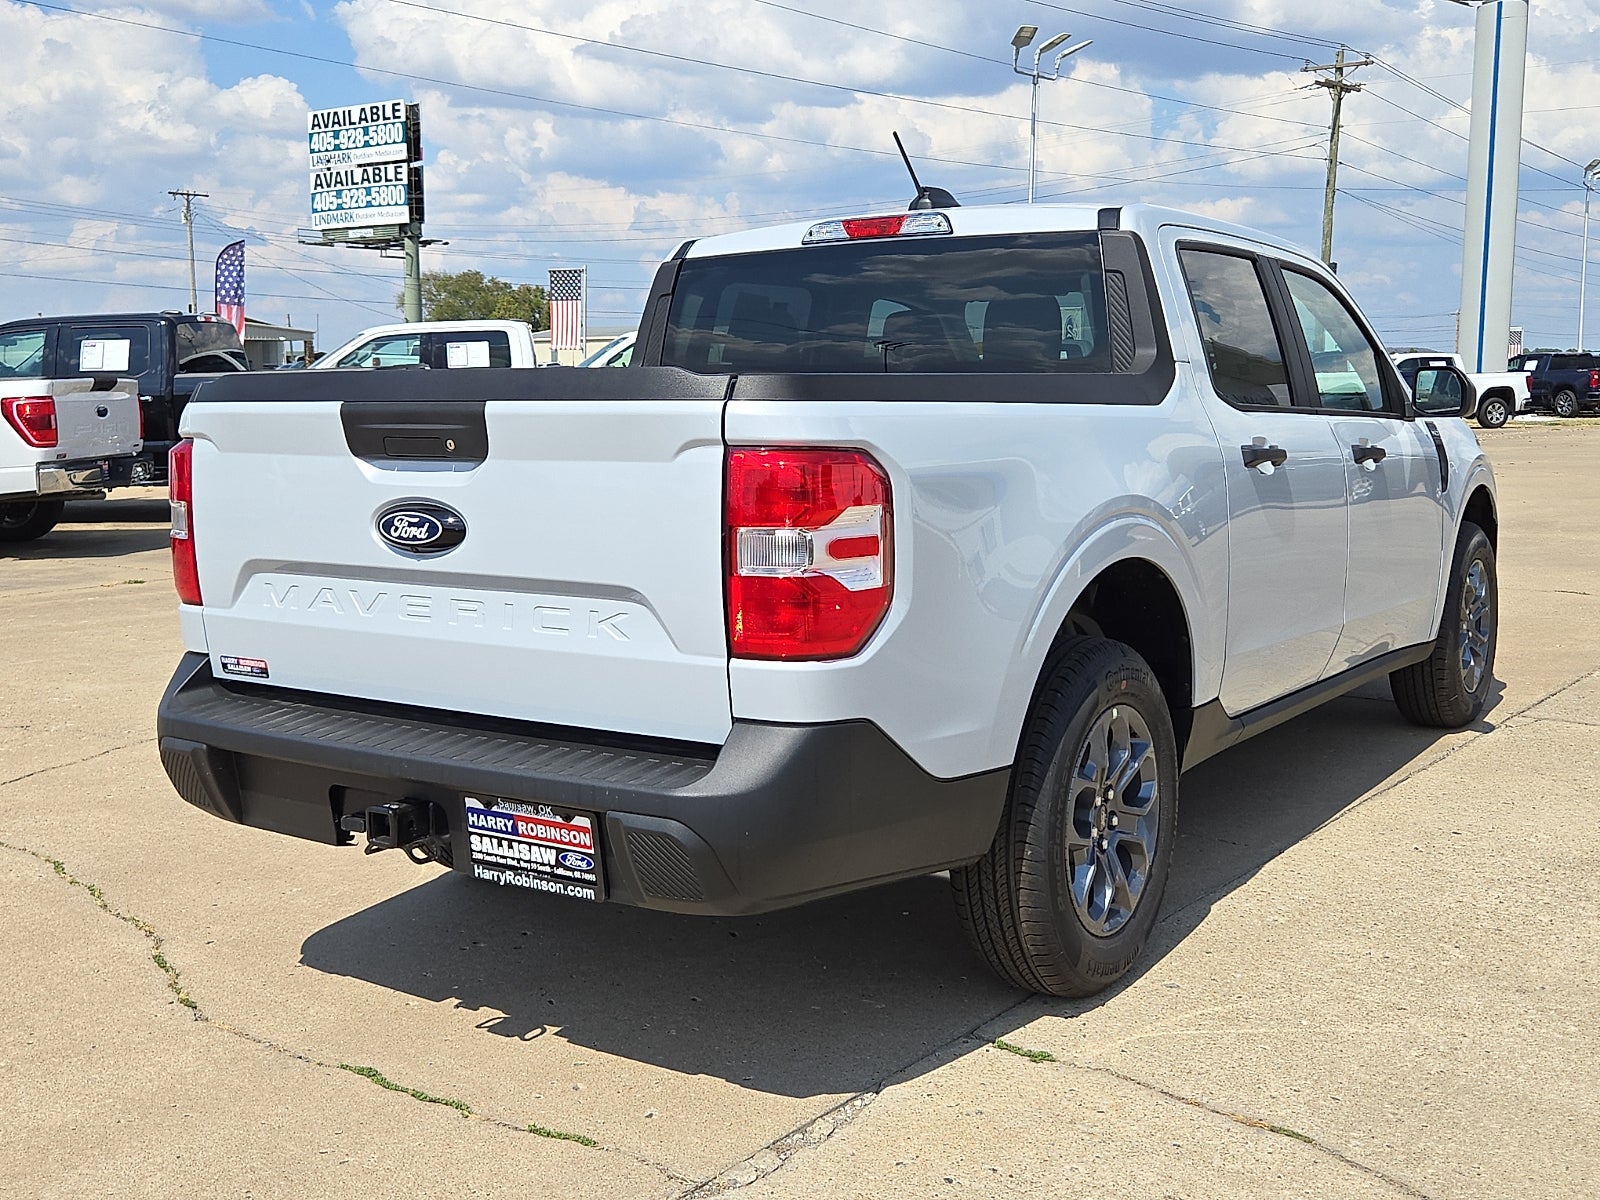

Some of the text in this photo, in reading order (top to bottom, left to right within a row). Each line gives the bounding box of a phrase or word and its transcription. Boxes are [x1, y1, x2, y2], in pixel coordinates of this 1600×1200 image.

[311, 102, 401, 130] AVAILABLE
[310, 122, 403, 152] 405-928-5800
[314, 165, 403, 190] AVAILABLE
[313, 185, 405, 212] 405-928-5800
[390, 515, 429, 539] Ford
[263, 582, 631, 642] MAVERICK
[467, 812, 514, 832] HARRY
[517, 820, 591, 846] ROBINSON
[470, 834, 556, 865] SALLISAW
[565, 853, 588, 868] Ford
[474, 864, 595, 900] HarryRobinson.com
